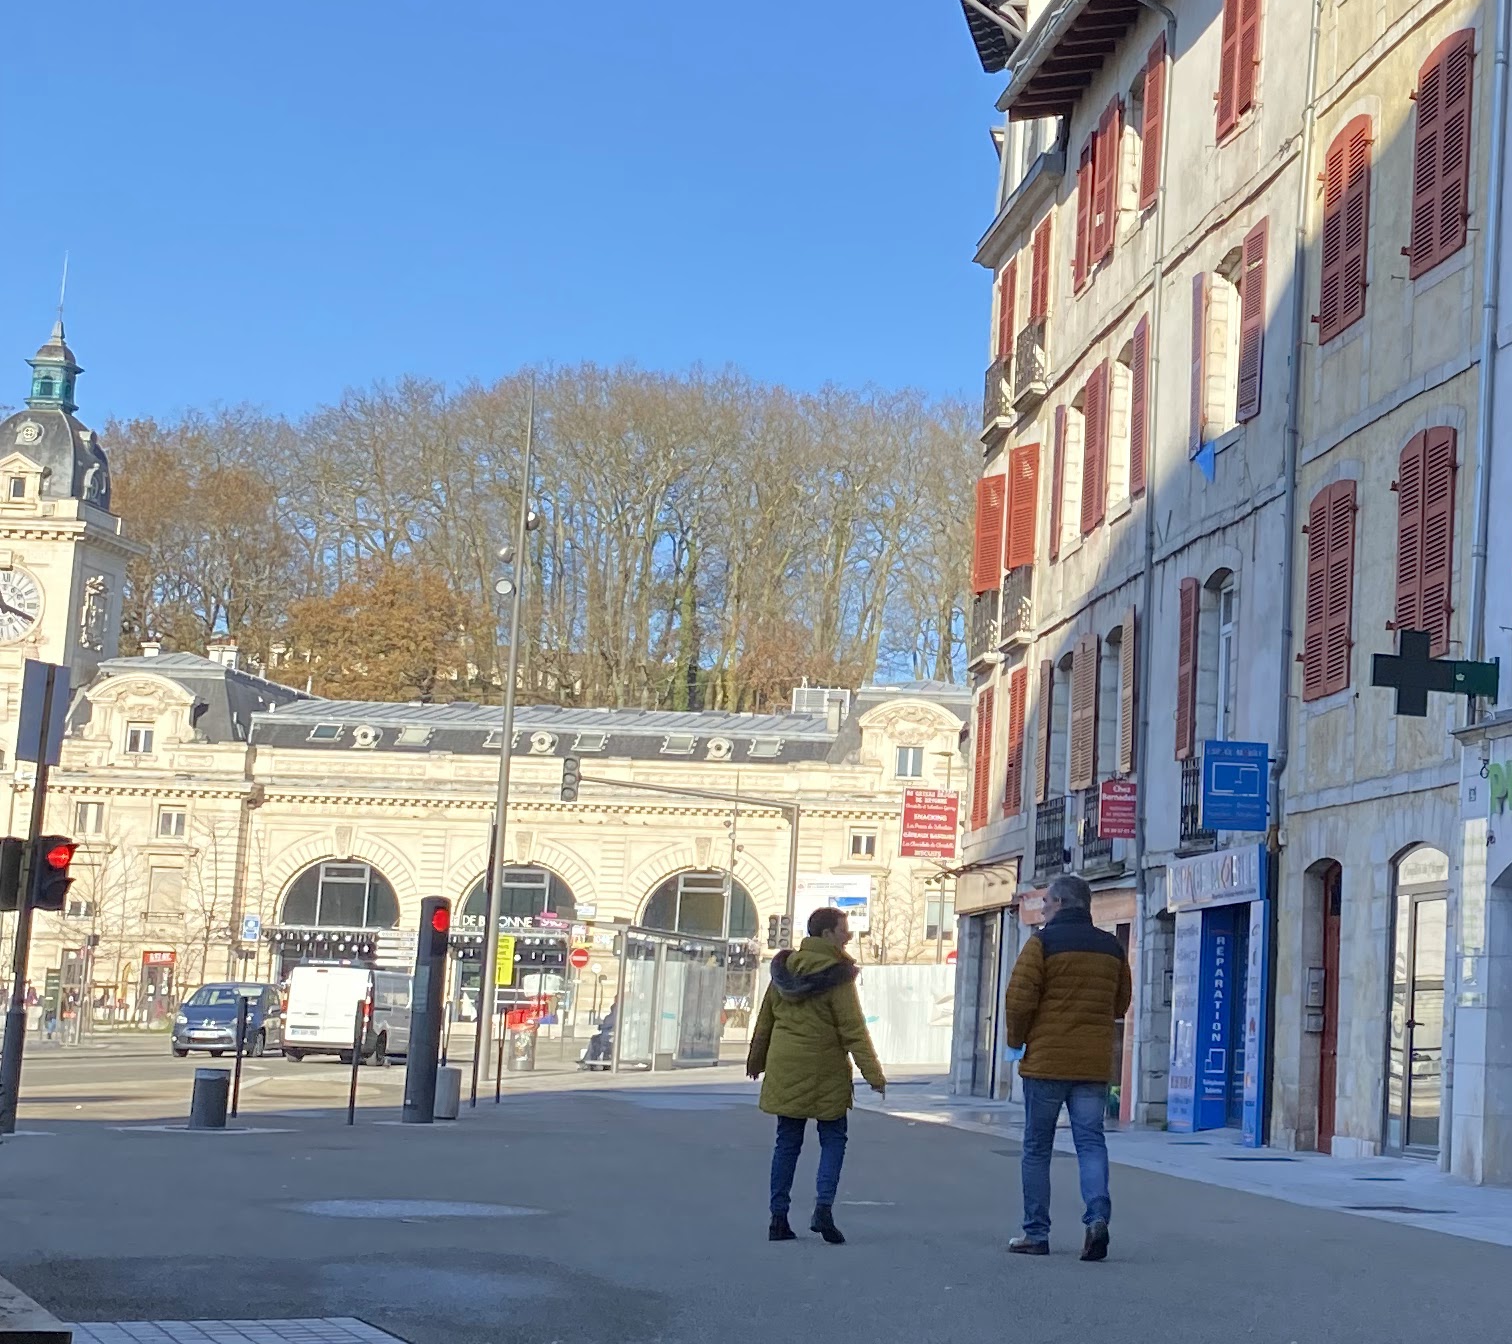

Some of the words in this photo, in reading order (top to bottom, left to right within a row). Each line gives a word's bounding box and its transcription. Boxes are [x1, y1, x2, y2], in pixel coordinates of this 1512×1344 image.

[462, 915, 477, 927] DE
[478, 916, 533, 928] BONNE
[1211, 936, 1226, 1042] REPARATION
